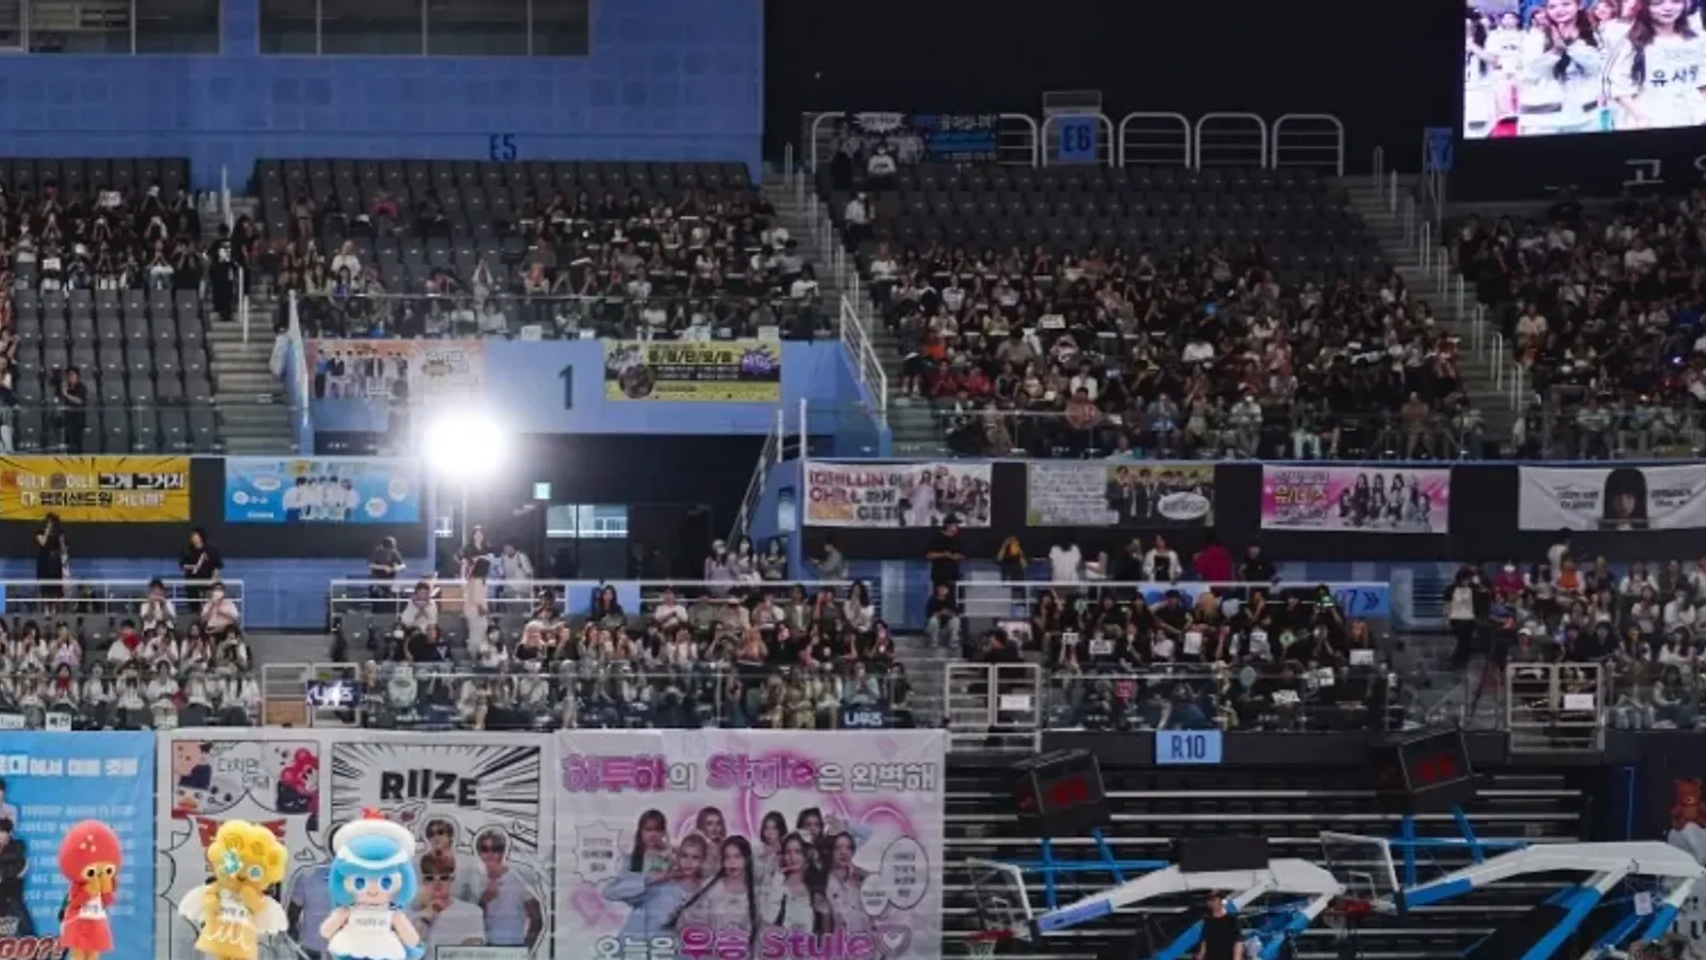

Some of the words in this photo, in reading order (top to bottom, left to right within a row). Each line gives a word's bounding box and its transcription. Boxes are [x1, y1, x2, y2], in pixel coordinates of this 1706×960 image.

[490, 134, 517, 159] E5
[1063, 124, 1090, 152] E6
[559, 363, 574, 411] 1
[1171, 734, 1206, 759] R10
[380, 769, 480, 807] RIIZE
[849, 760, 936, 794] 완벽해
